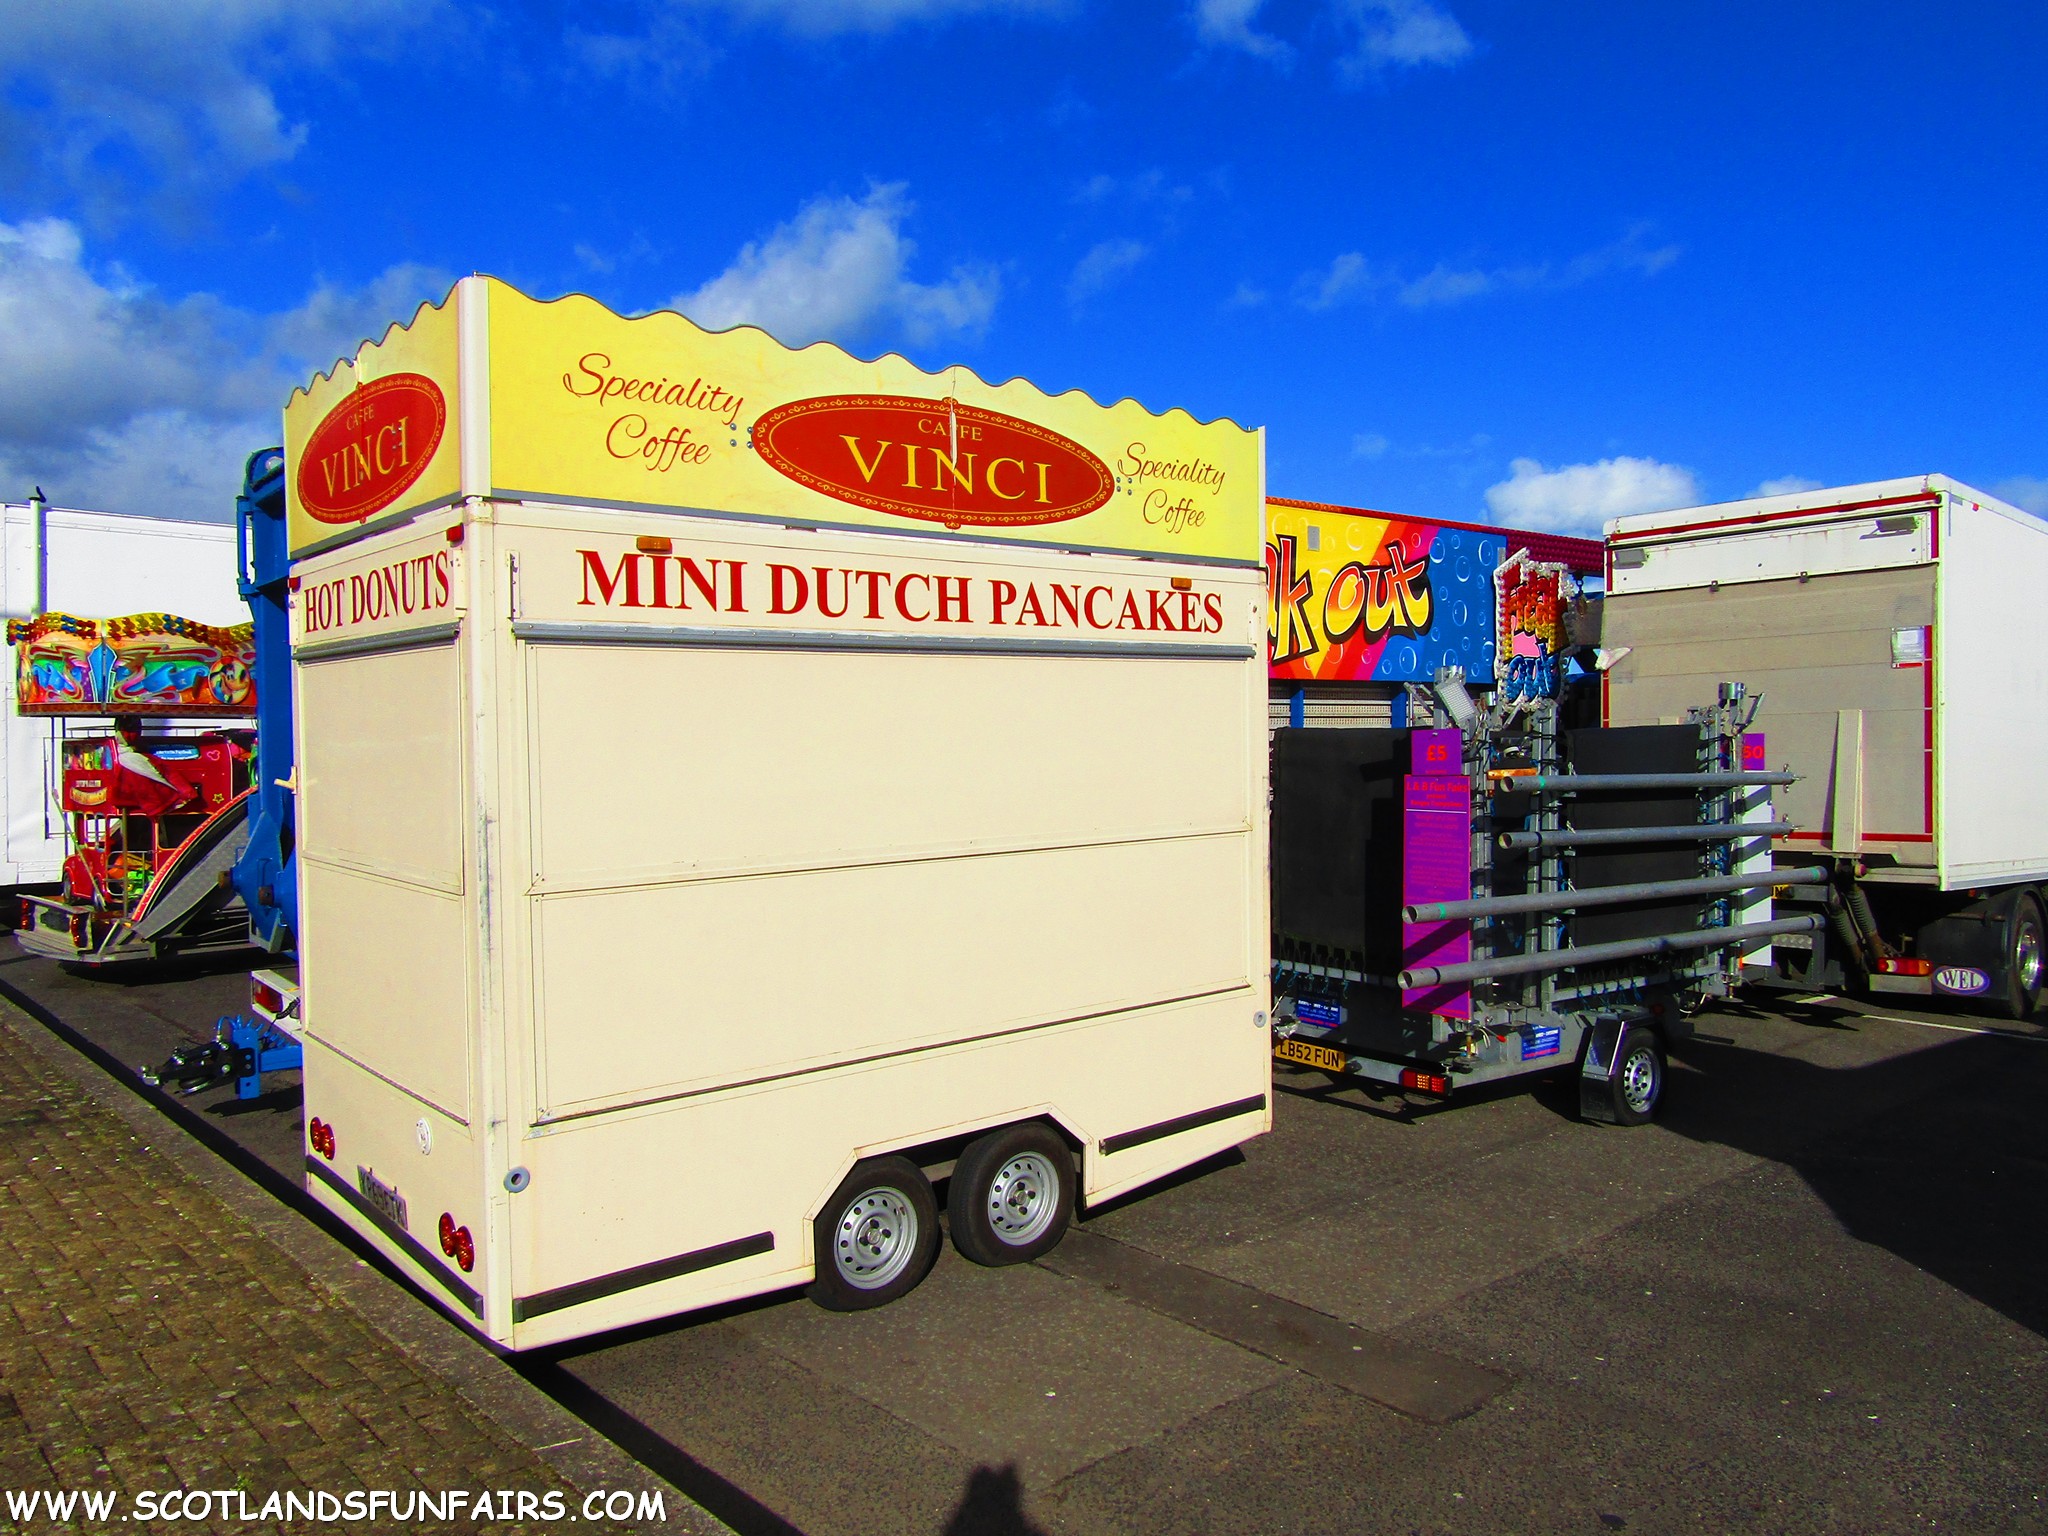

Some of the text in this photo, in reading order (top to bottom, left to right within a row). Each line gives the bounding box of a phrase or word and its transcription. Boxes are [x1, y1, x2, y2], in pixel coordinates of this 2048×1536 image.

[563, 353, 744, 424] Speciality
[320, 416, 410, 498] VINCI
[606, 413, 711, 472] Coffee
[839, 434, 1053, 504] VINCI
[1117, 442, 1226, 495] Speciality
[1143, 488, 1206, 534] Coffee
[304, 549, 449, 633] HOT DONUTS
[576, 549, 1224, 634] MINI DUTCH PANCAKES
[1323, 544, 1433, 644] out
[1427, 744, 1448, 761] £5
[1941, 968, 1981, 989] WEL
[1279, 1042, 1340, 1068] LB52 FUN
